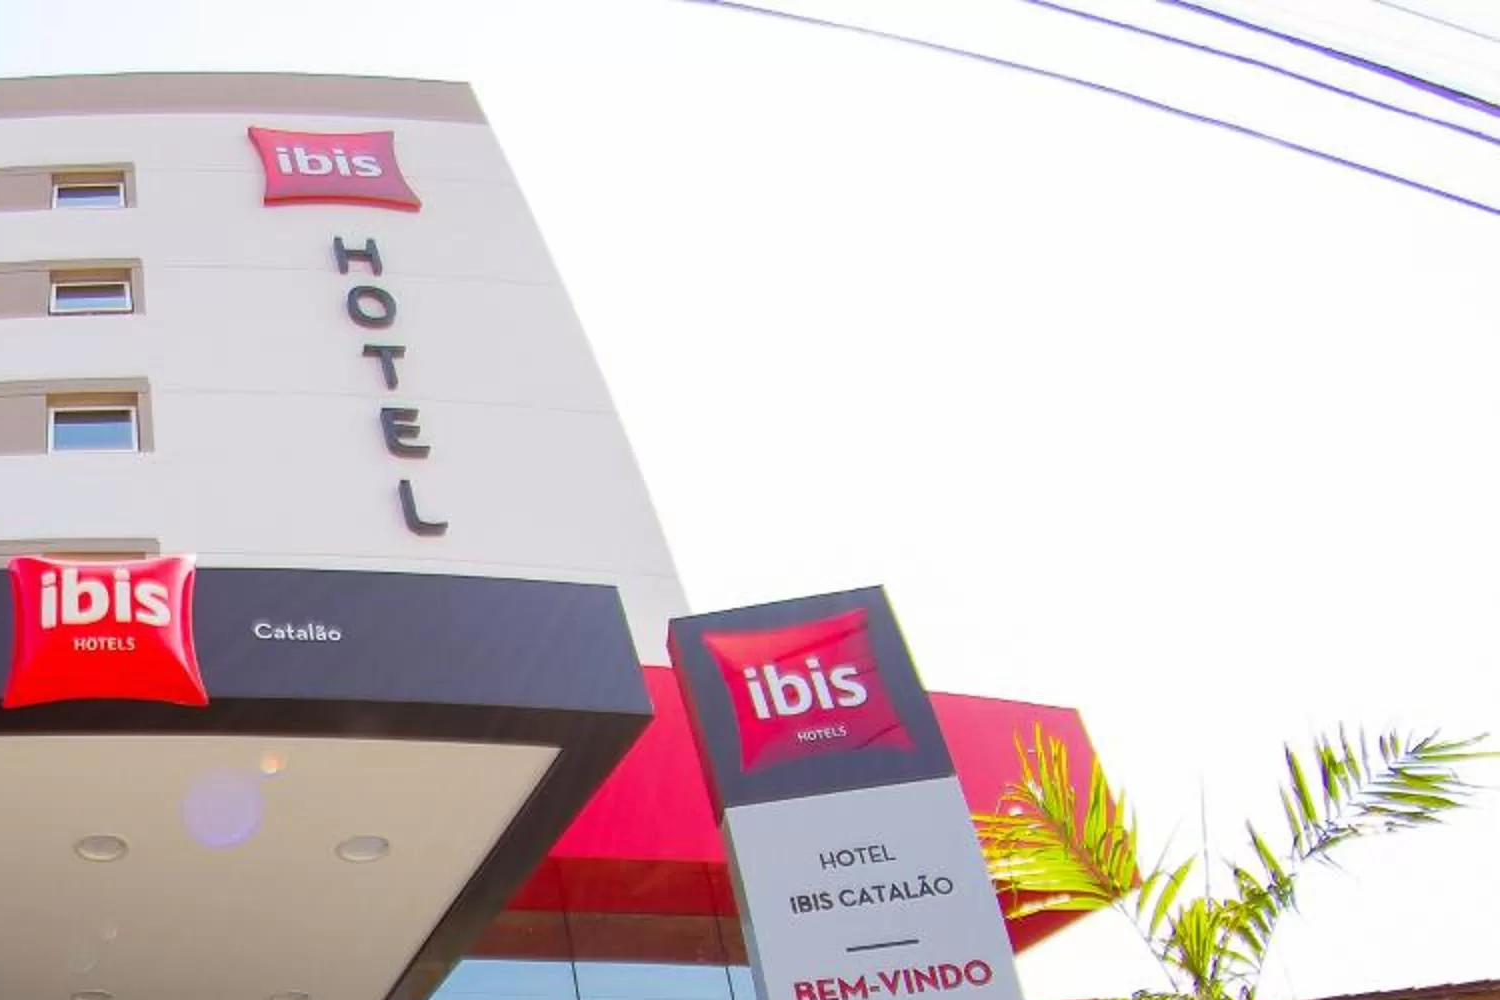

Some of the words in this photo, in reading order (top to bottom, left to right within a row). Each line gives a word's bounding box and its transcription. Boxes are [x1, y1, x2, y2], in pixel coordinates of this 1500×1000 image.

[275, 146, 383, 178] ibis
[333, 235, 449, 538] HOTEL
[40, 567, 173, 630] ibis
[73, 635, 136, 652] HOTELS
[253, 622, 342, 642] Catalão
[742, 656, 869, 720] ibis
[796, 724, 848, 743] HOTELS
[818, 844, 897, 871] HOTEL
[789, 893, 834, 915] IBIS
[838, 874, 954, 909] CATALÃO
